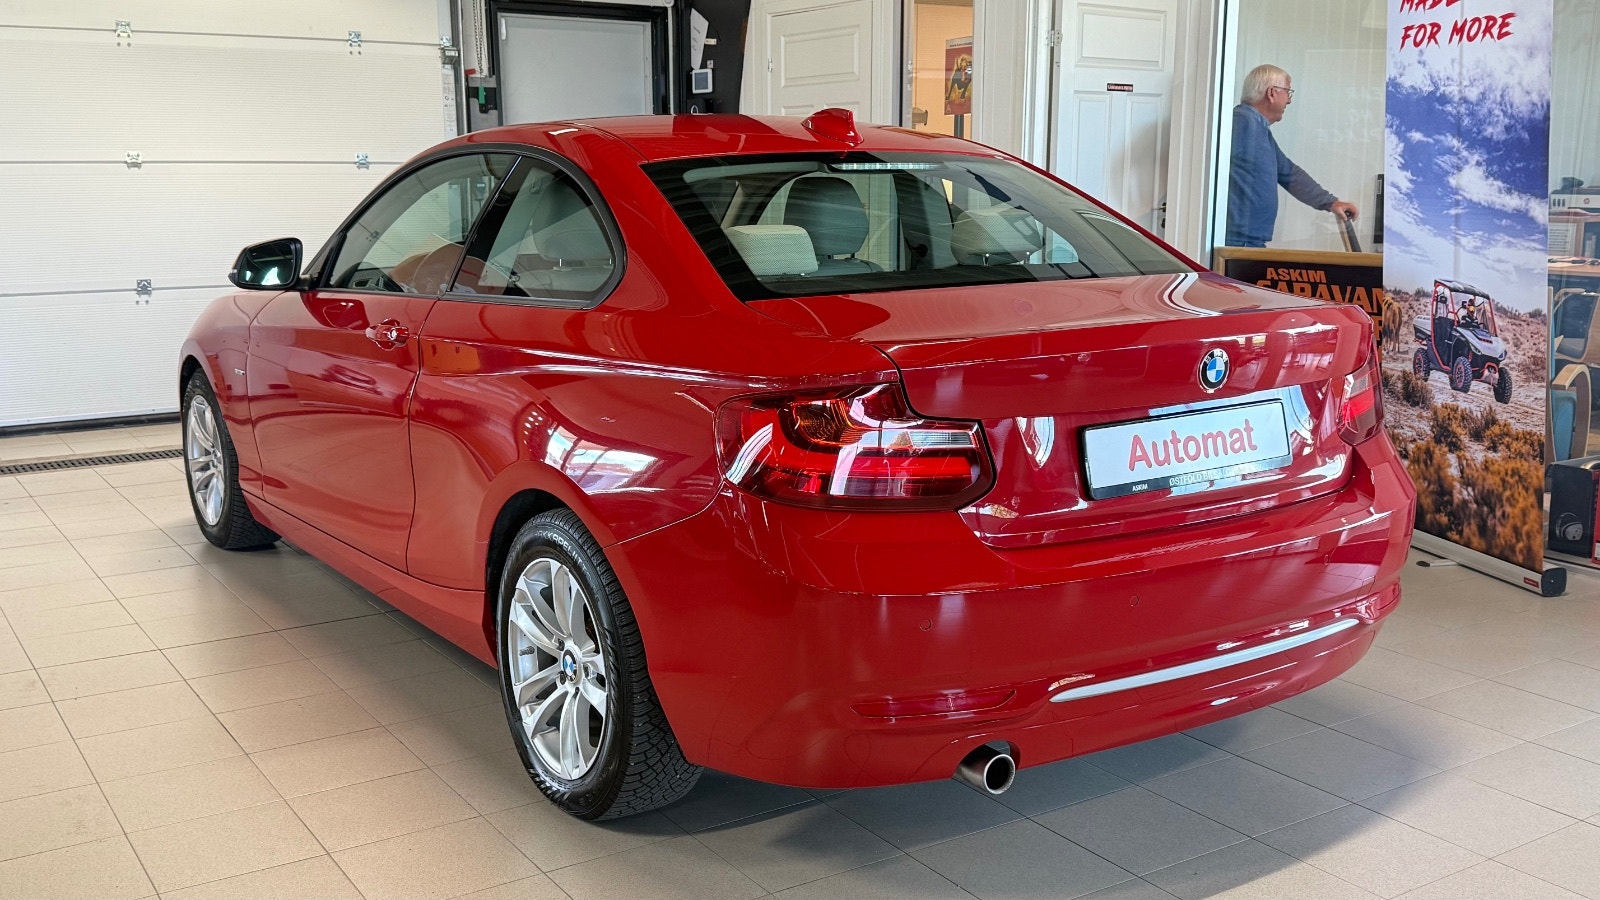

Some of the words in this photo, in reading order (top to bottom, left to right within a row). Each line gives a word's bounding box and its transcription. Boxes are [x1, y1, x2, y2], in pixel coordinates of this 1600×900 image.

[1399, 0, 1460, 14] MA
[1399, 22, 1441, 51] FOR
[1448, 12, 1518, 46] MORE
[1266, 267, 1327, 283] ASKIM
[1256, 280, 1383, 313] RAVA
[1128, 418, 1258, 471] Automat
[1132, 483, 1148, 492] ASKIM
[1169, 474, 1203, 486] ØSTFOLD
